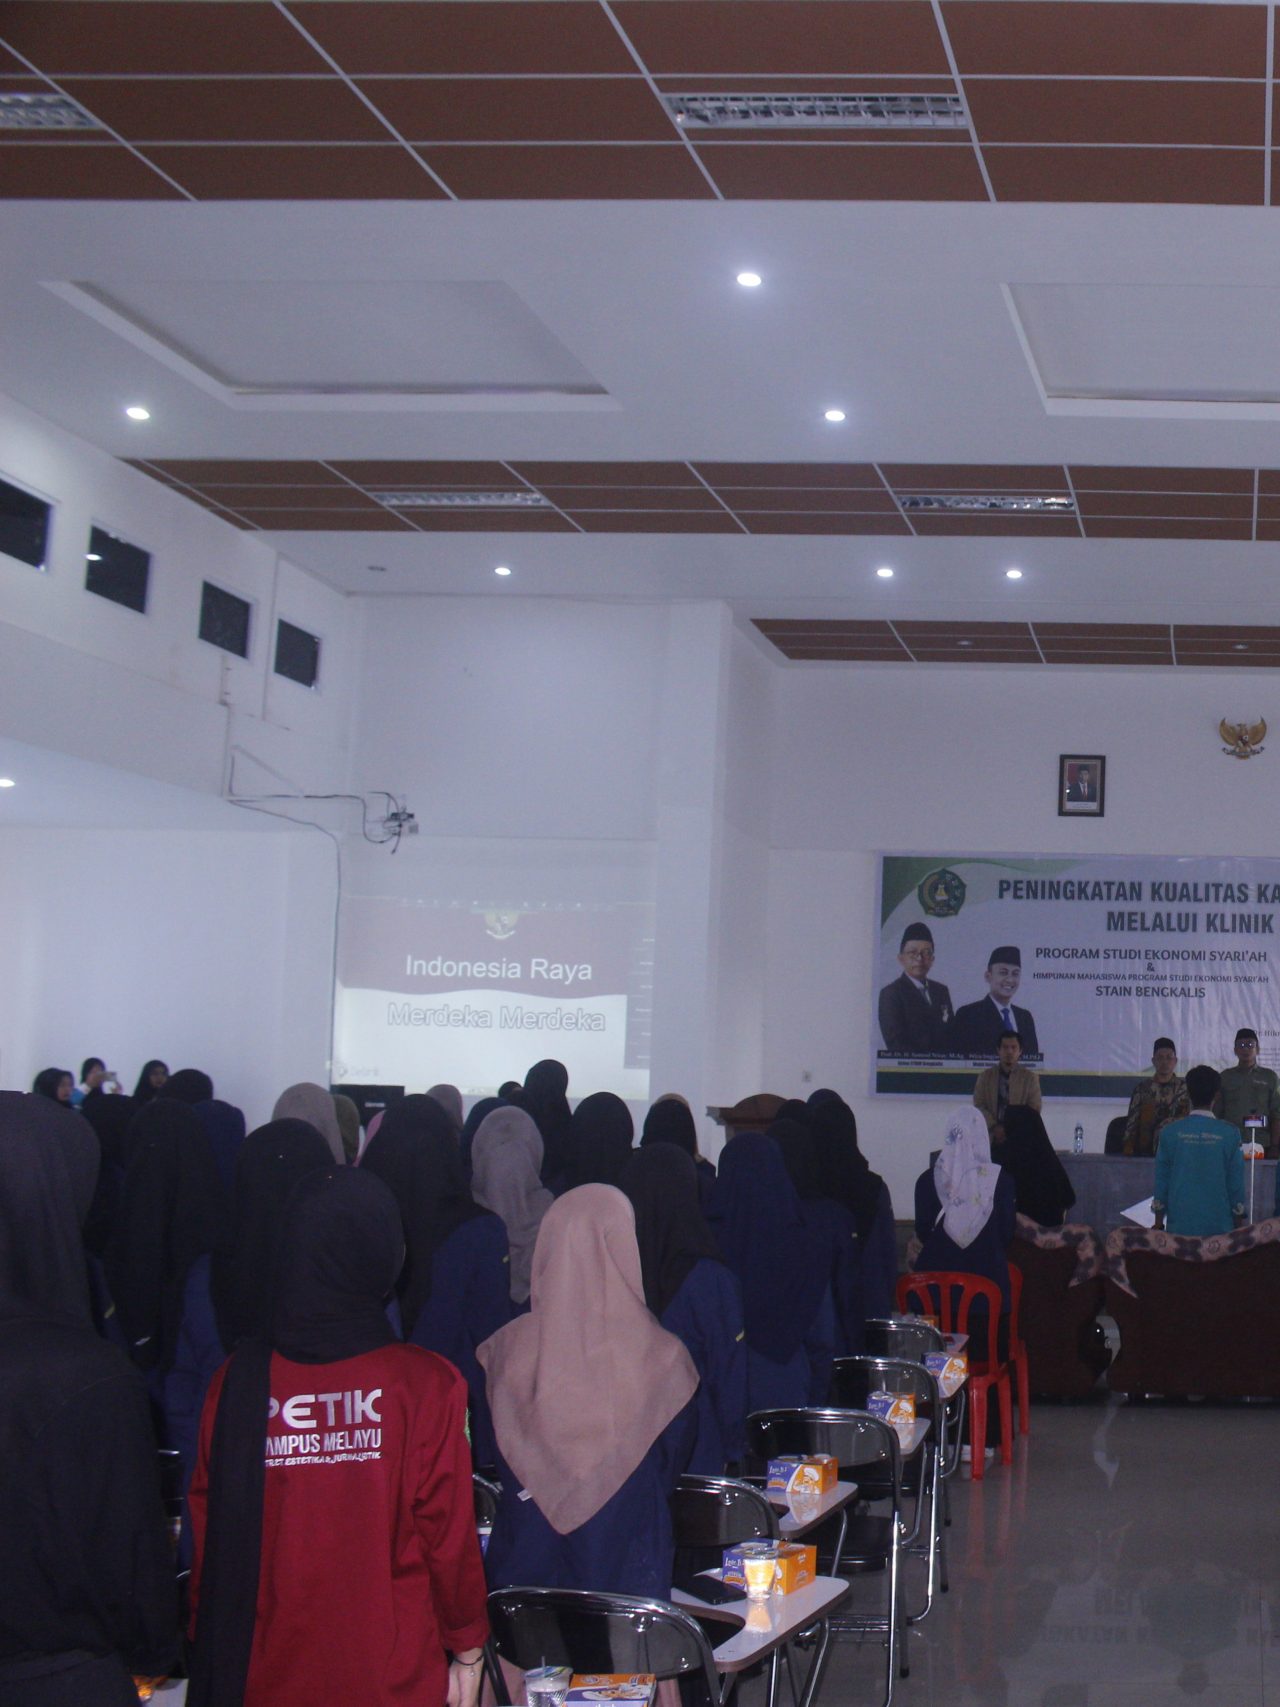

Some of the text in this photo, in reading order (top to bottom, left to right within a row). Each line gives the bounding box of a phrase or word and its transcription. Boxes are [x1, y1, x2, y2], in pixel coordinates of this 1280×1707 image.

[998, 879, 1142, 900] PENINGKATAN
[1151, 882, 1248, 903] KUALITAS
[1107, 911, 1197, 932] MELALUI
[1206, 913, 1273, 933] KLINIK
[1035, 947, 1267, 962] PROGRAM STUDI EKONOMI SYARI'AH
[405, 954, 593, 985] Indonesia Raya
[1033, 972, 1075, 980] HIMPUNAN
[1077, 973, 1126, 981] MAHASISWA
[1128, 974, 1167, 982] PROGRAM
[1169, 974, 1192, 982] STUDI
[1194, 975, 1232, 983] EKONOMI
[1146, 962, 1155, 972] &
[1095, 985, 1206, 998] STAIN BENGKALIS
[387, 1002, 606, 1031] Merdeka Merdeka
[265, 1428, 382, 1457] AMPUS MELAYU
